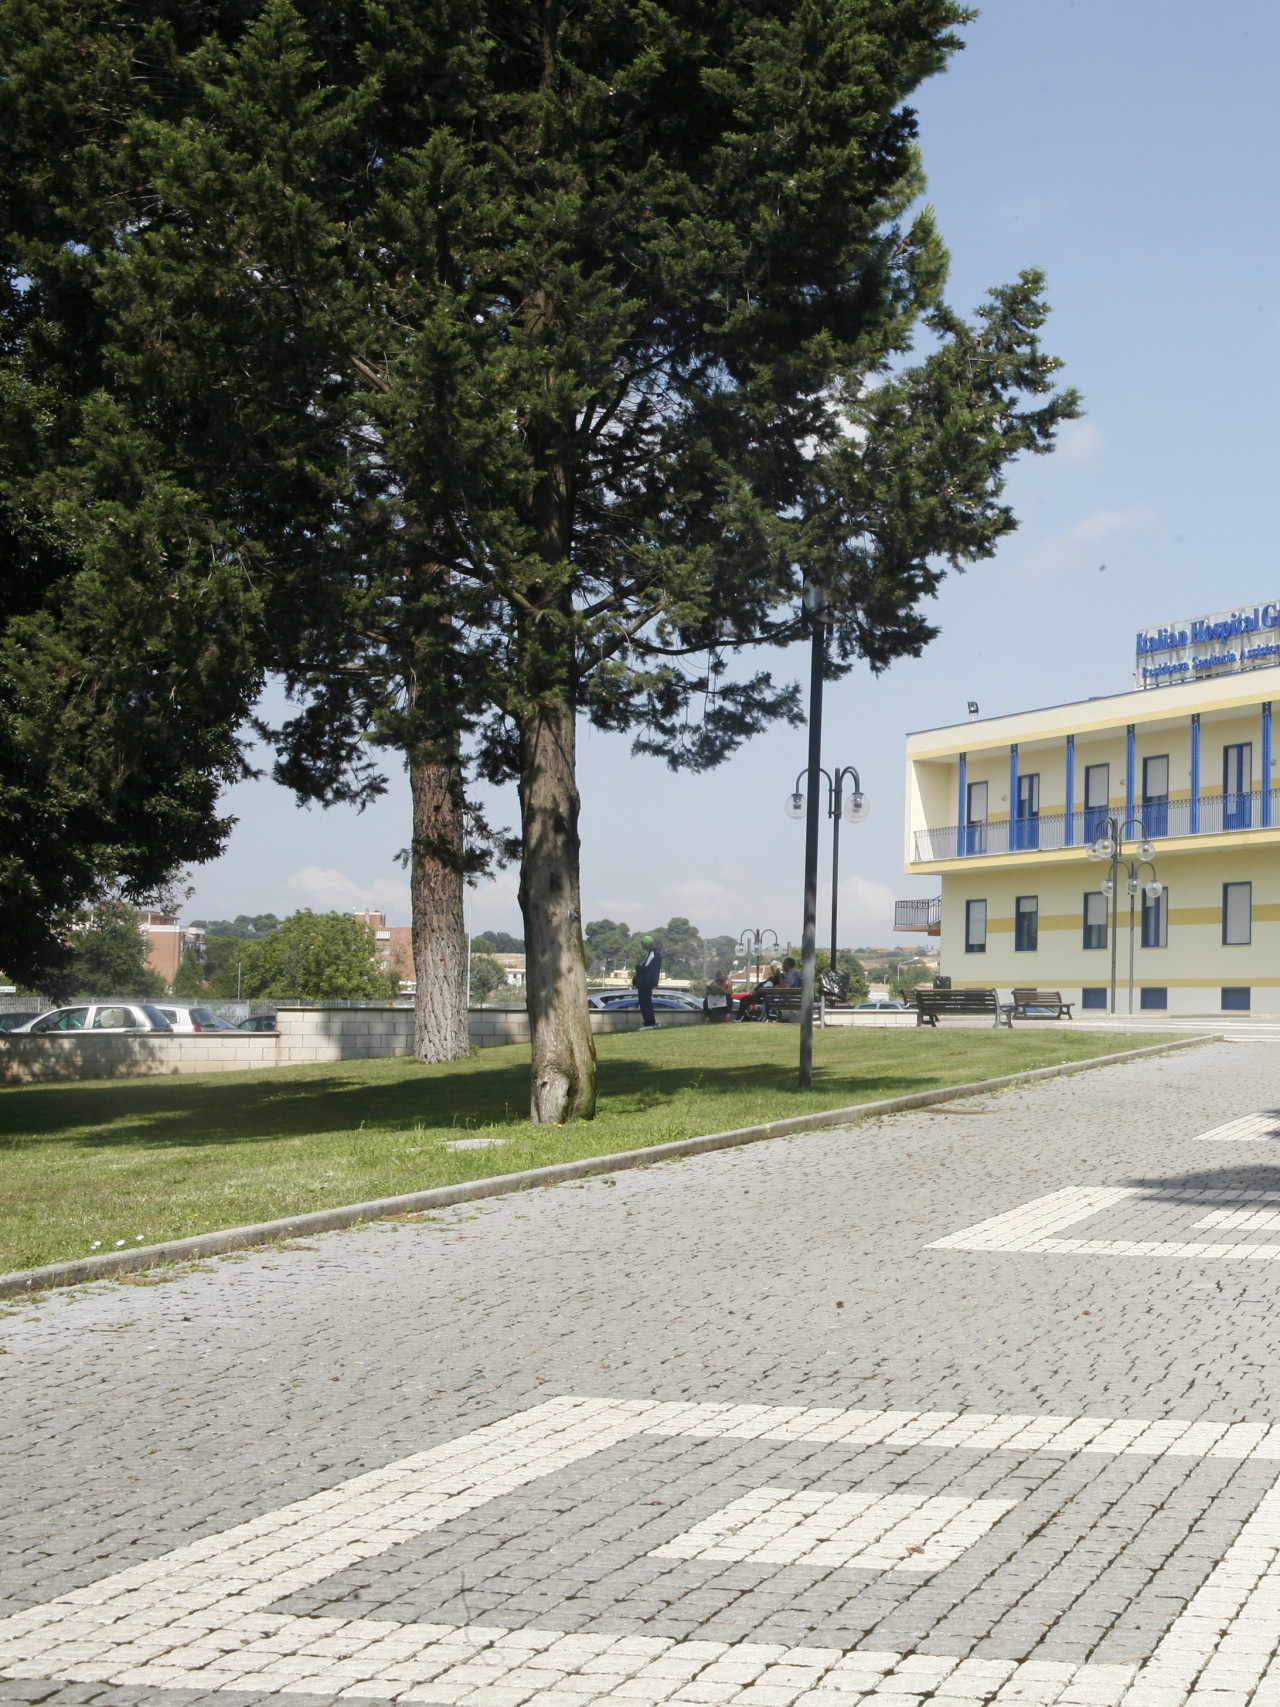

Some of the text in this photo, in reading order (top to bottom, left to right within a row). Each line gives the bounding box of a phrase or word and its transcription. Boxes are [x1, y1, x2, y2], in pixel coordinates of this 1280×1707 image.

[1136, 627, 1189, 655] Italian
[1190, 608, 1260, 645] Hospital
[1192, 650, 1236, 669] Sanitaria
